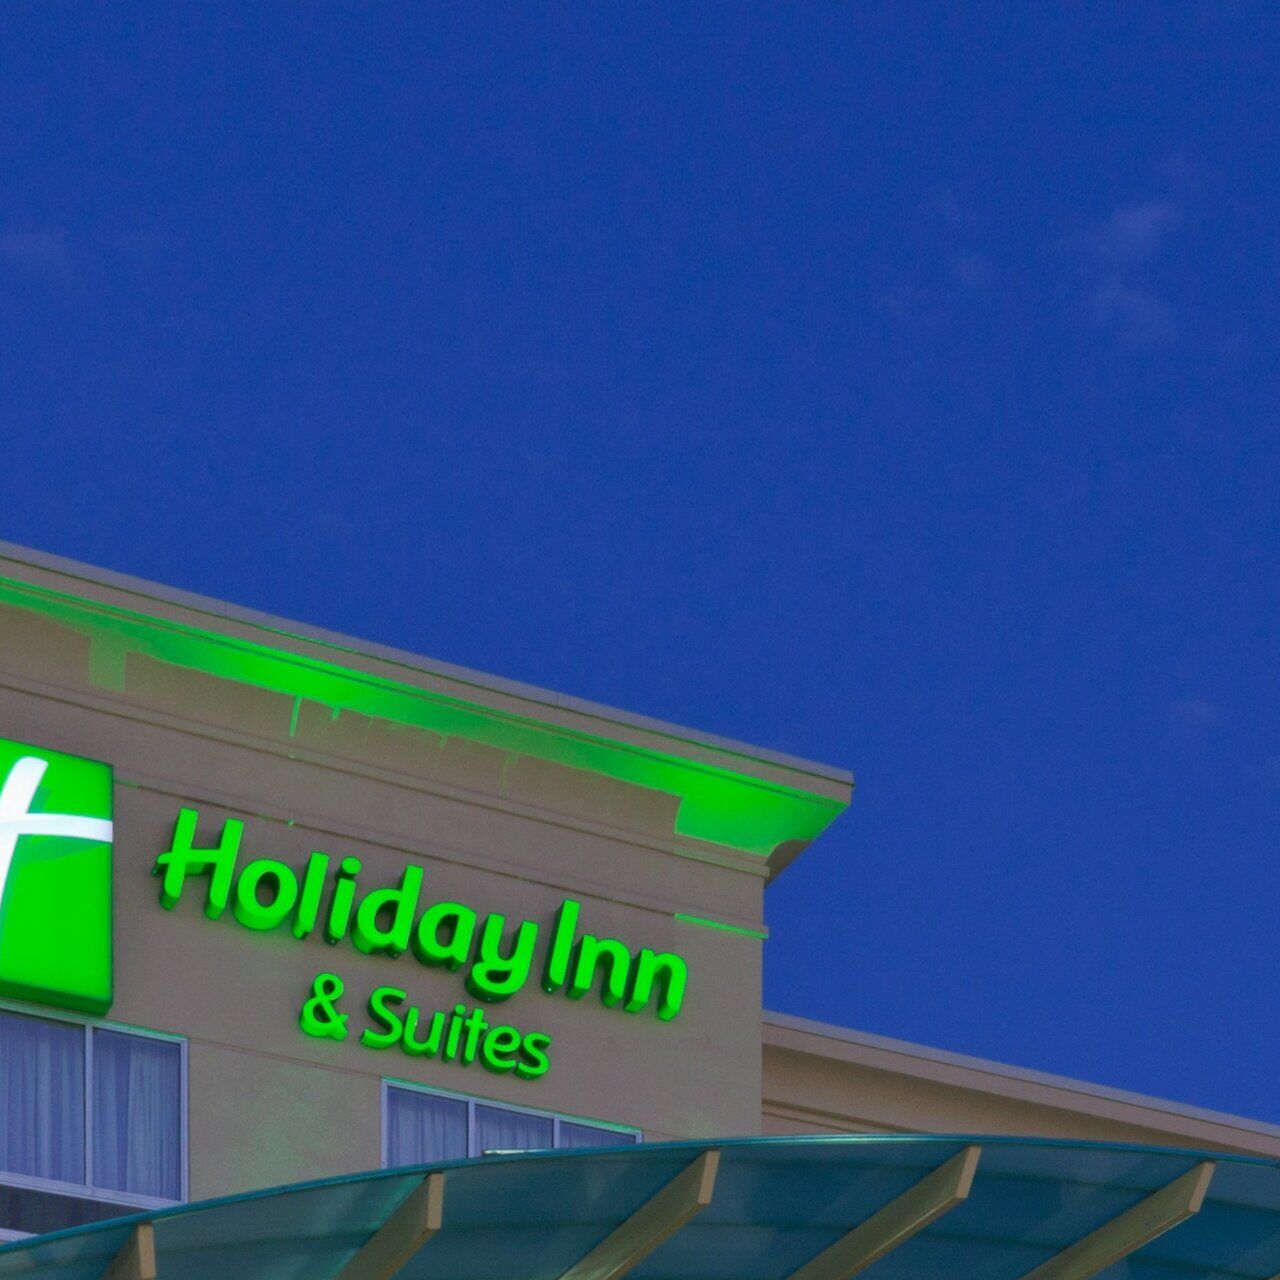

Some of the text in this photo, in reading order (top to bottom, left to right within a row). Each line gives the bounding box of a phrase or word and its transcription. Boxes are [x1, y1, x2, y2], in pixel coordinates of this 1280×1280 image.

[154, 806, 688, 1021] Holiday Inn
[299, 972, 553, 1080] & Suites
